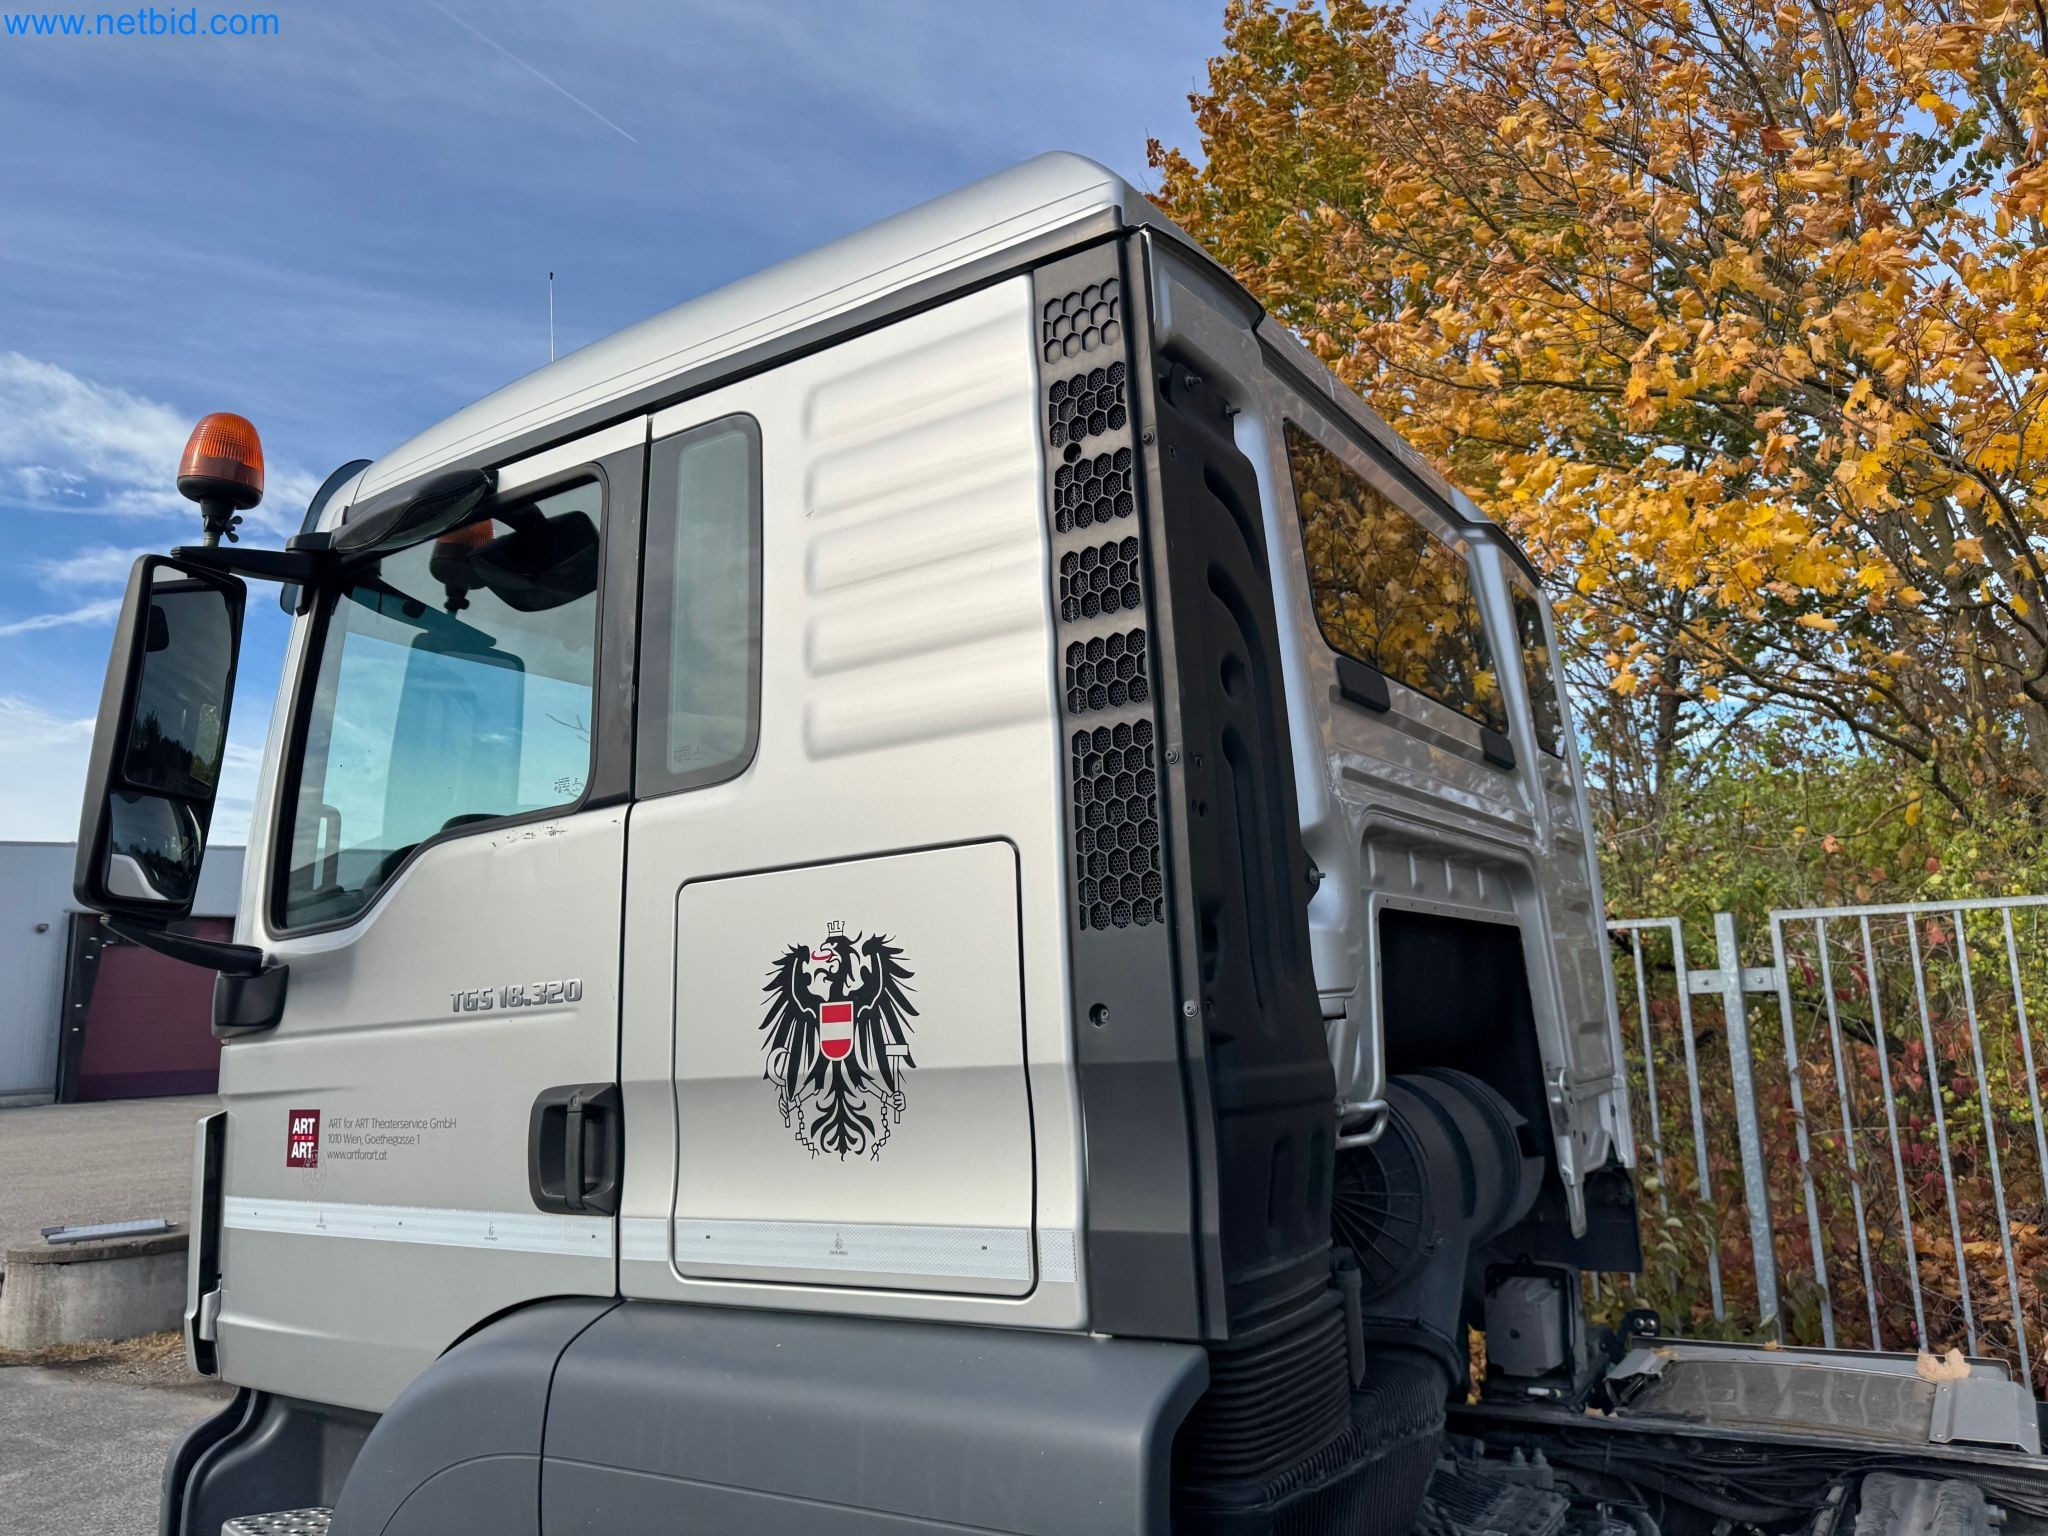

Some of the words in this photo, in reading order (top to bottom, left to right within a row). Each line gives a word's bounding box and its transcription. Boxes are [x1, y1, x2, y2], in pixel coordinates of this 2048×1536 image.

[451, 987, 493, 1012] TGS
[498, 978, 582, 1008] 18.320
[292, 1117, 316, 1135] ART
[328, 1117, 341, 1129] ART
[343, 1117, 353, 1129] for
[355, 1117, 369, 1129] ART
[371, 1117, 428, 1129] Theaterservice
[430, 1117, 457, 1129] GmbH
[328, 1133, 342, 1144] 1010
[343, 1133, 363, 1146] Wien,
[365, 1133, 415, 1147] Goethegasse
[291, 1141, 315, 1159] ART
[326, 1149, 388, 1161] www.artforart.at
